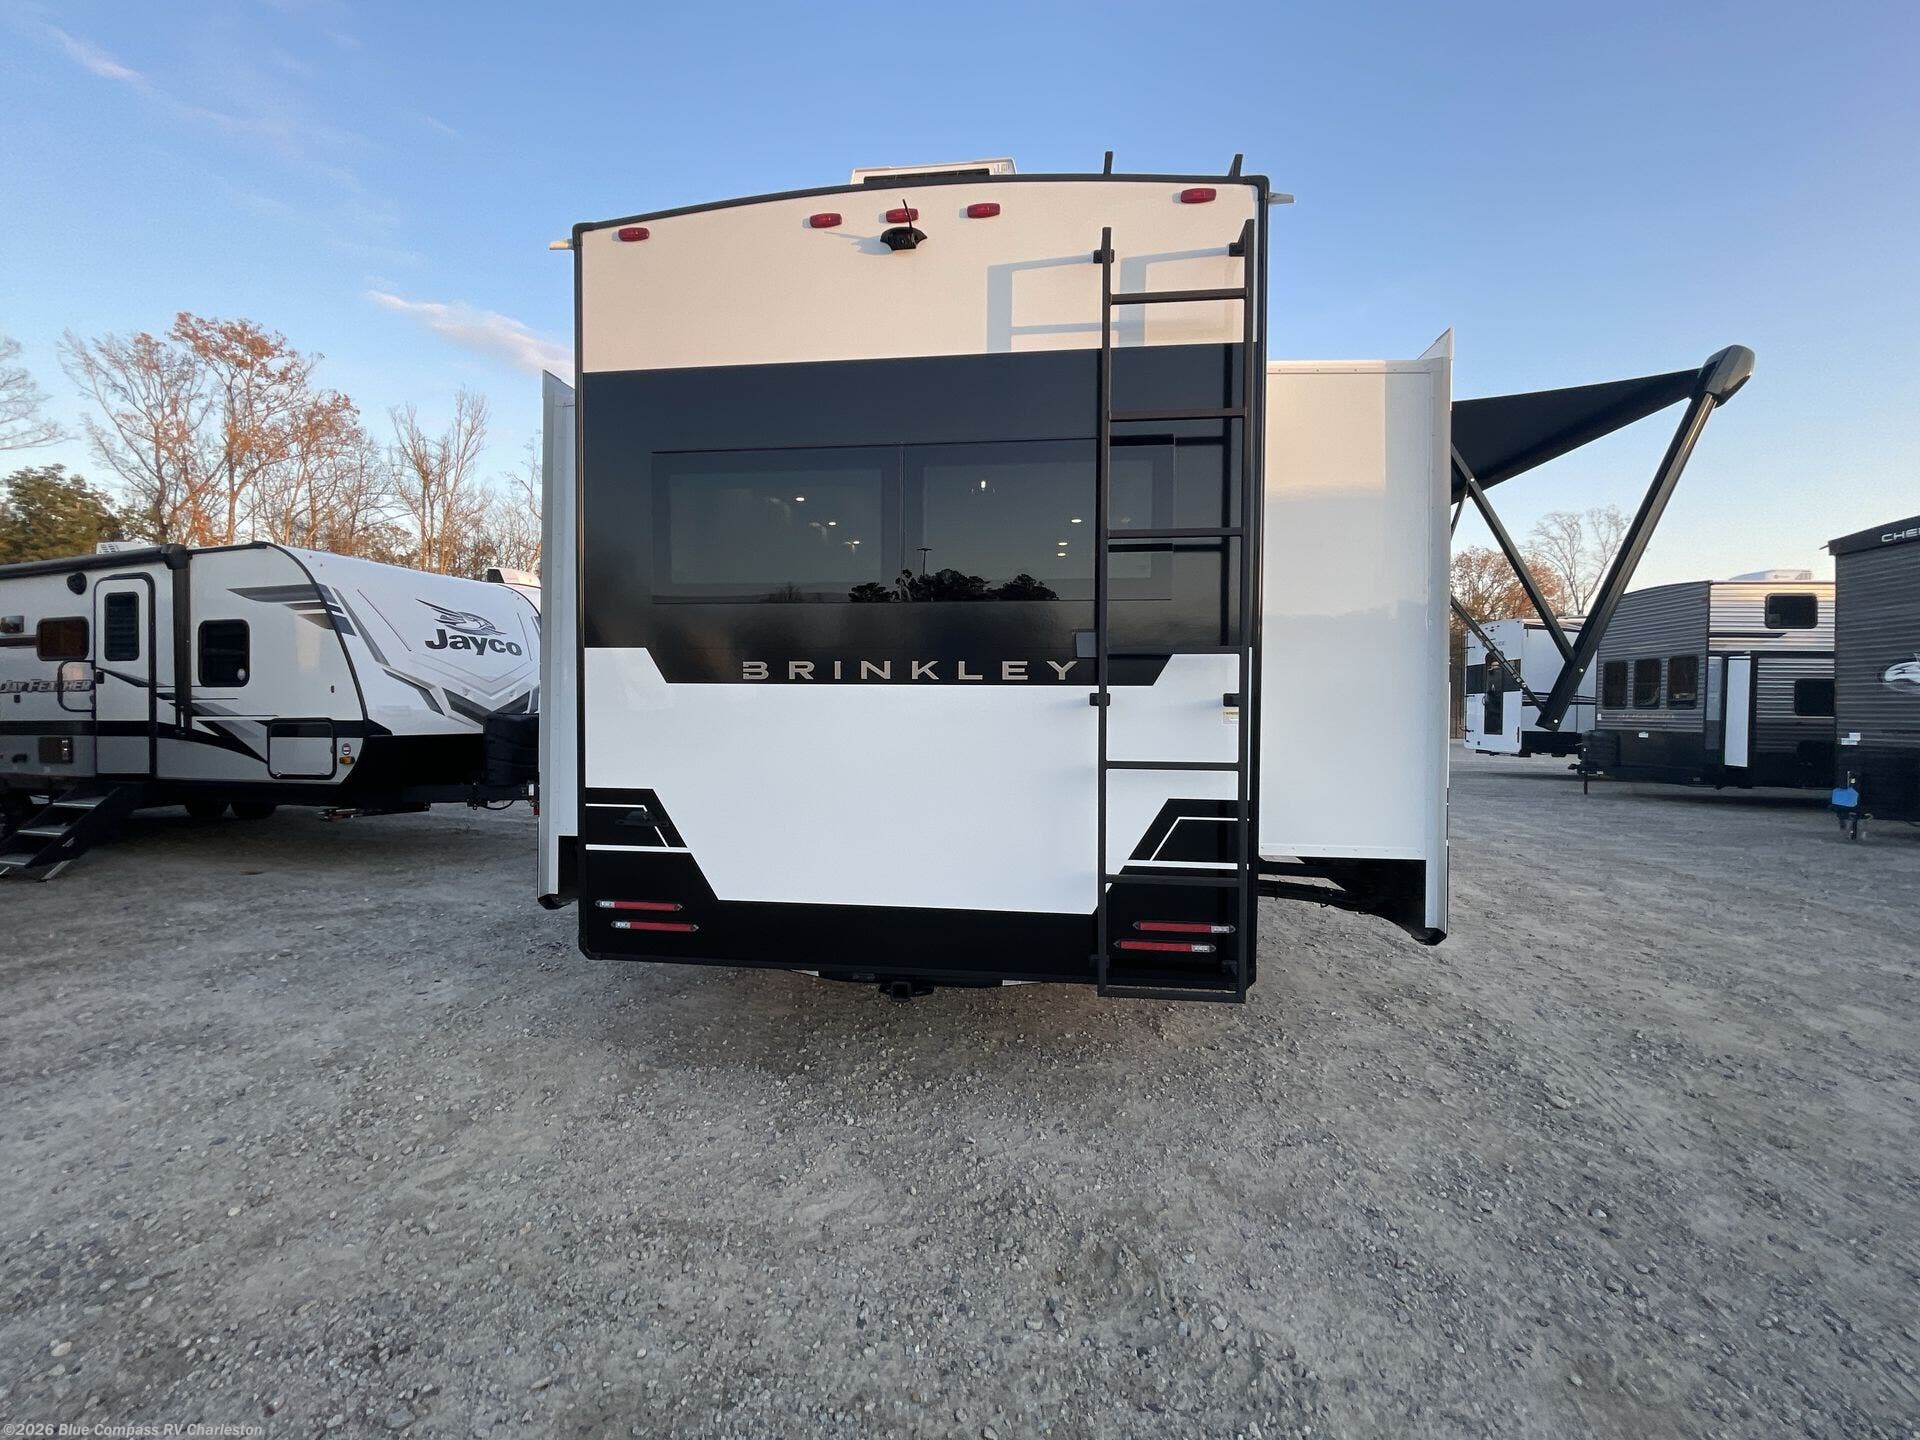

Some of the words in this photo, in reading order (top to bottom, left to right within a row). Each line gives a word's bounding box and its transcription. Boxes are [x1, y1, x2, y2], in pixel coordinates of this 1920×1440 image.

[1881, 527, 1920, 543] CHE
[424, 628, 523, 656] Jayco
[742, 660, 1078, 680] BRINKLEY
[27, 679, 91, 692] FEAHER
